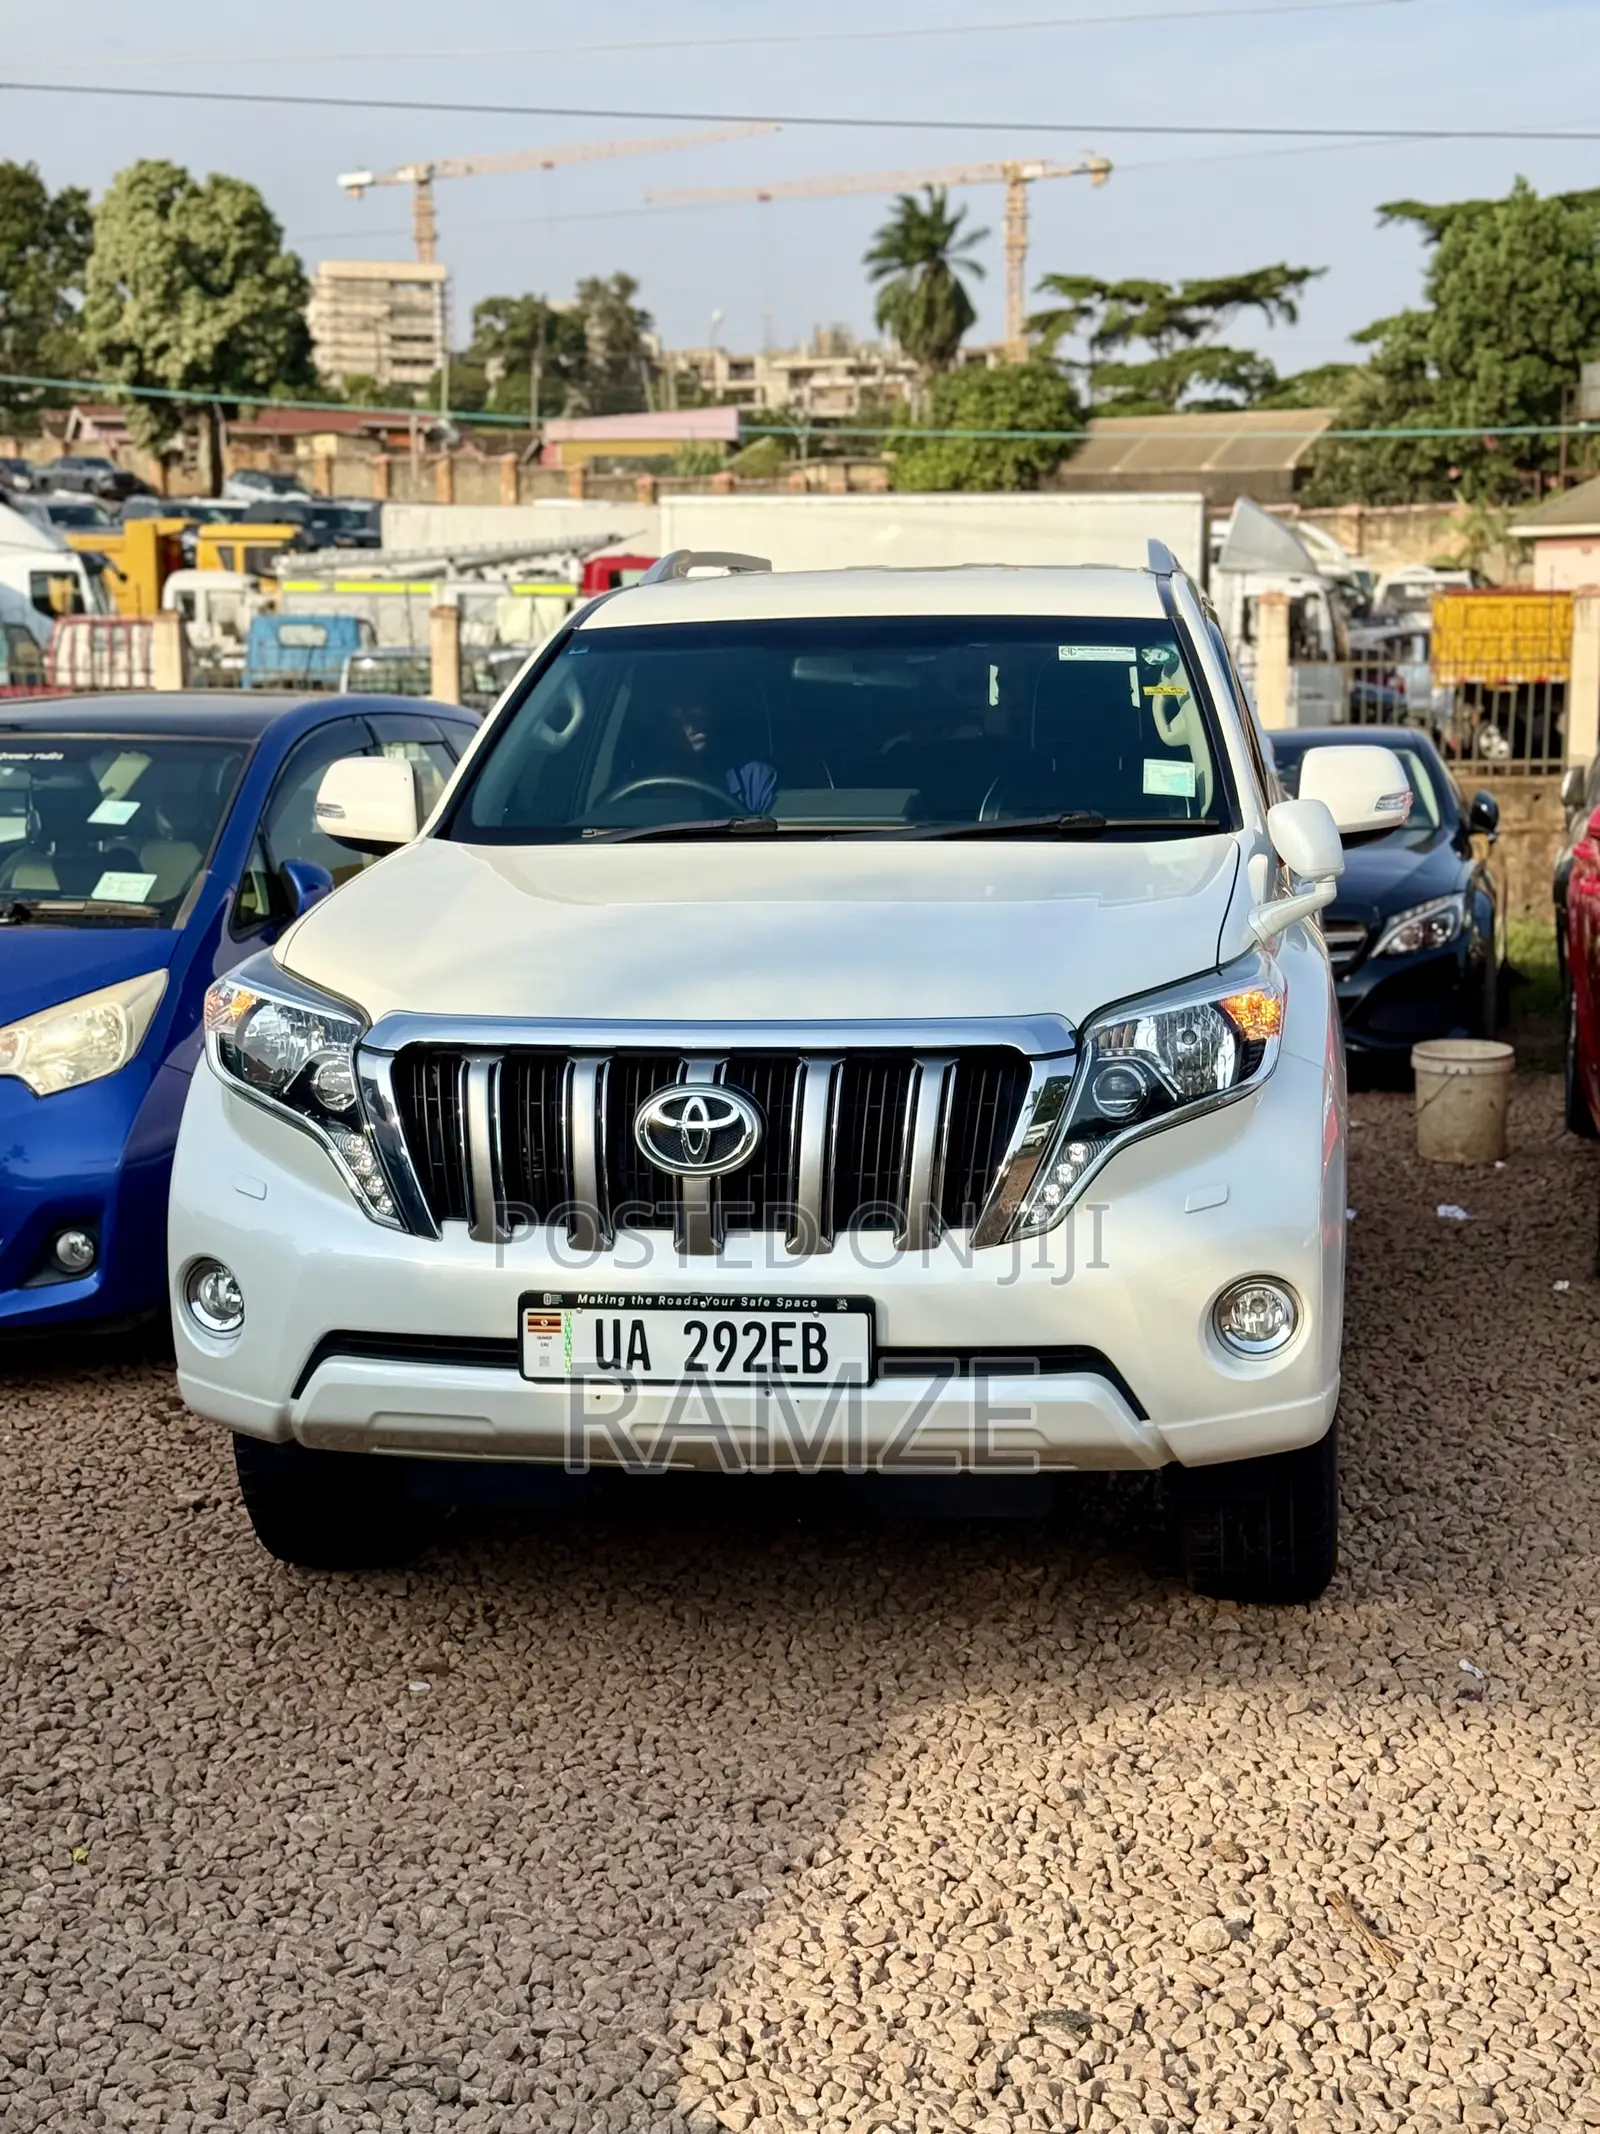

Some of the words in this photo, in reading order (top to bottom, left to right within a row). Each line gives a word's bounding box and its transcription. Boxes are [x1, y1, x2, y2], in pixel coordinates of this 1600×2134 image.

[577, 1293, 626, 1307] Making
[631, 1294, 653, 1306] the
[658, 1295, 699, 1306] Roads
[705, 1296, 735, 1307] Your
[740, 1297, 771, 1308] Safe
[776, 1297, 818, 1310] Space
[595, 1318, 652, 1371] UA
[683, 1320, 829, 1374] 292EB
